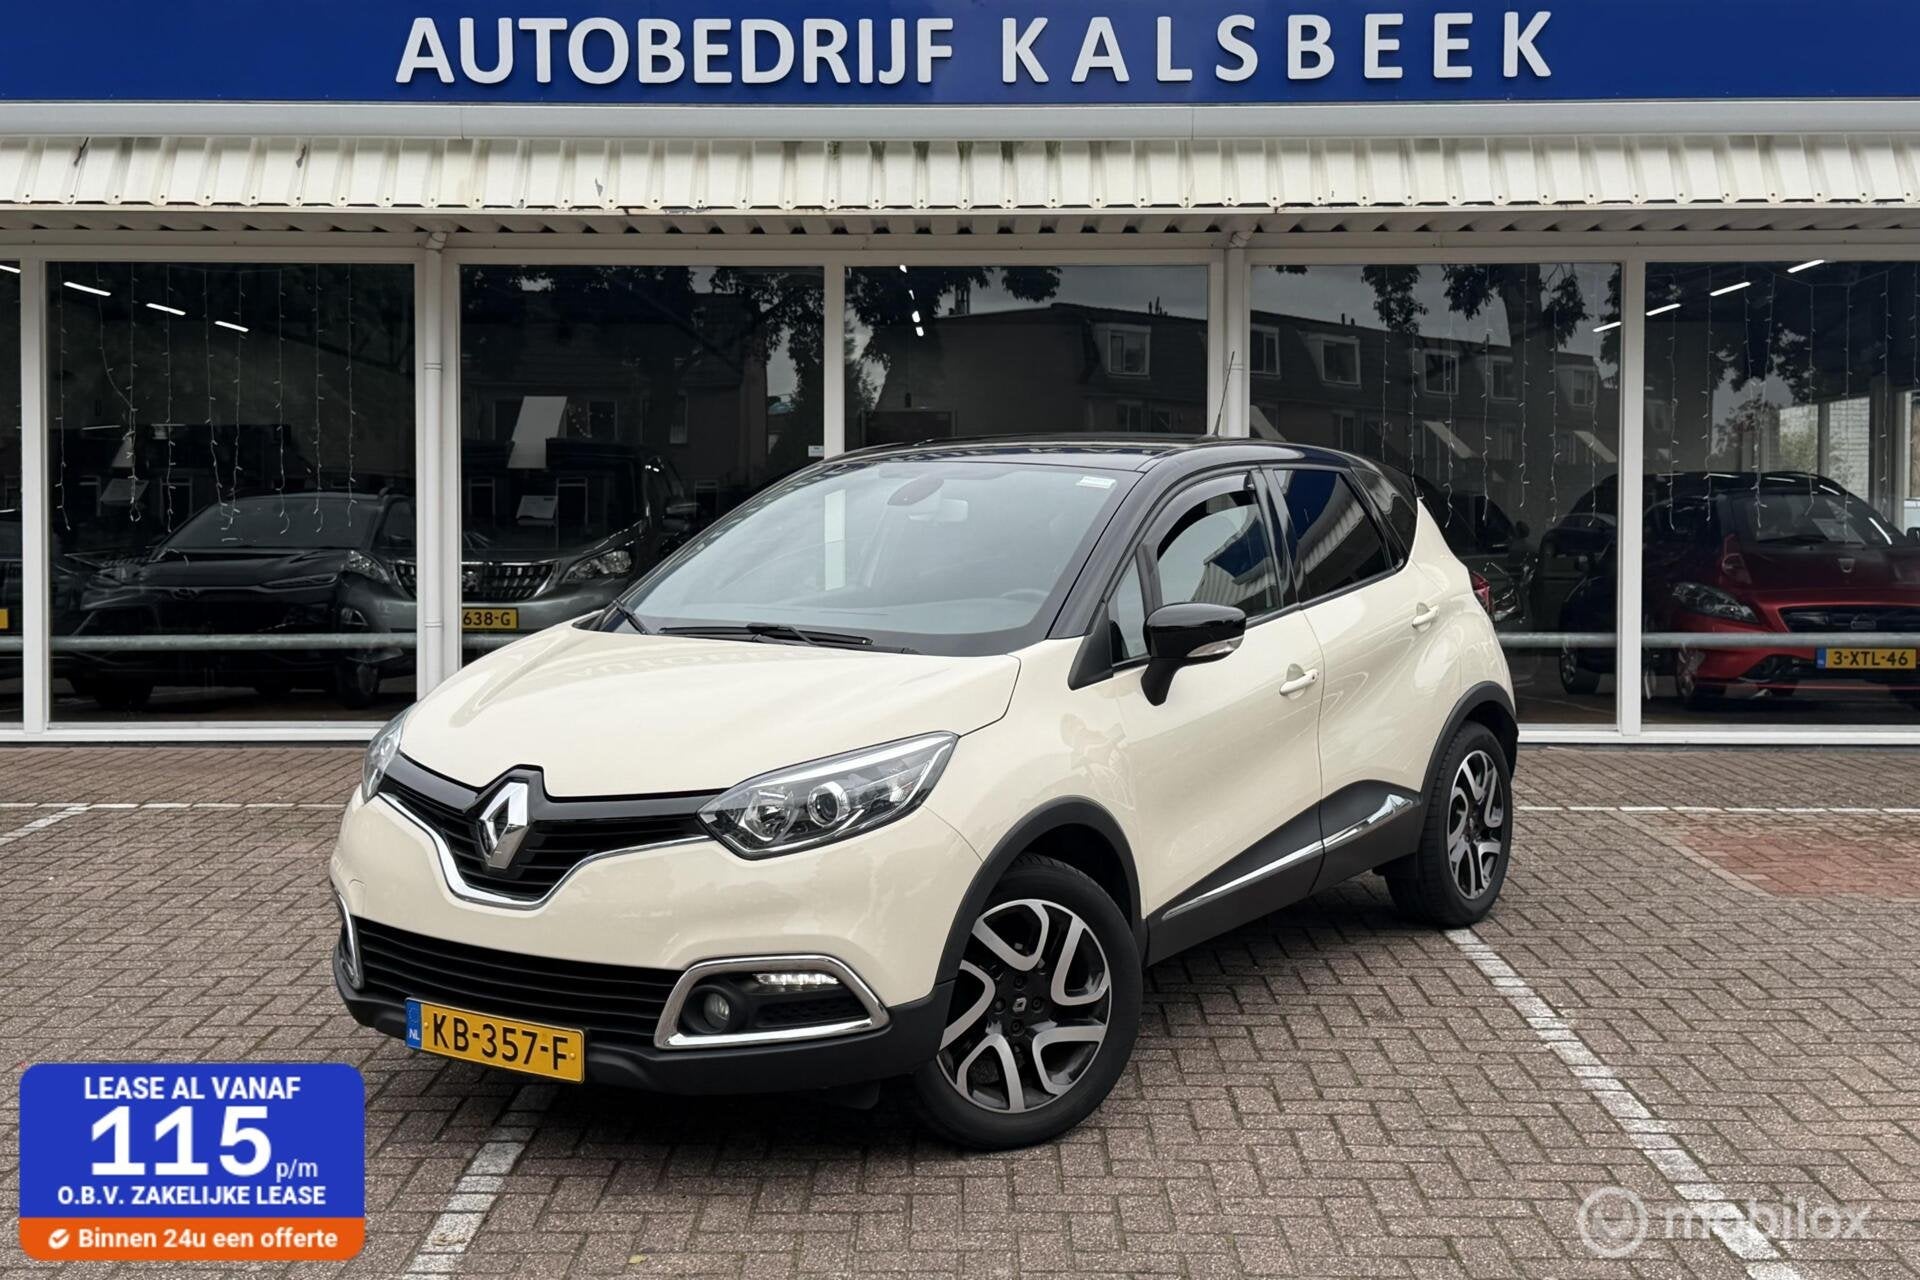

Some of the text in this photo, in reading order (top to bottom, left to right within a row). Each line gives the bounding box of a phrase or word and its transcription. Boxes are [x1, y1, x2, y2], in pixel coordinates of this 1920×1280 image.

[395, 11, 1552, 86] AUTOBEDRIJF KALSBEEK
[1833, 651, 1909, 666] 3-XTL-46
[409, 1028, 420, 1040] NL
[433, 1013, 568, 1070] KB-357-F
